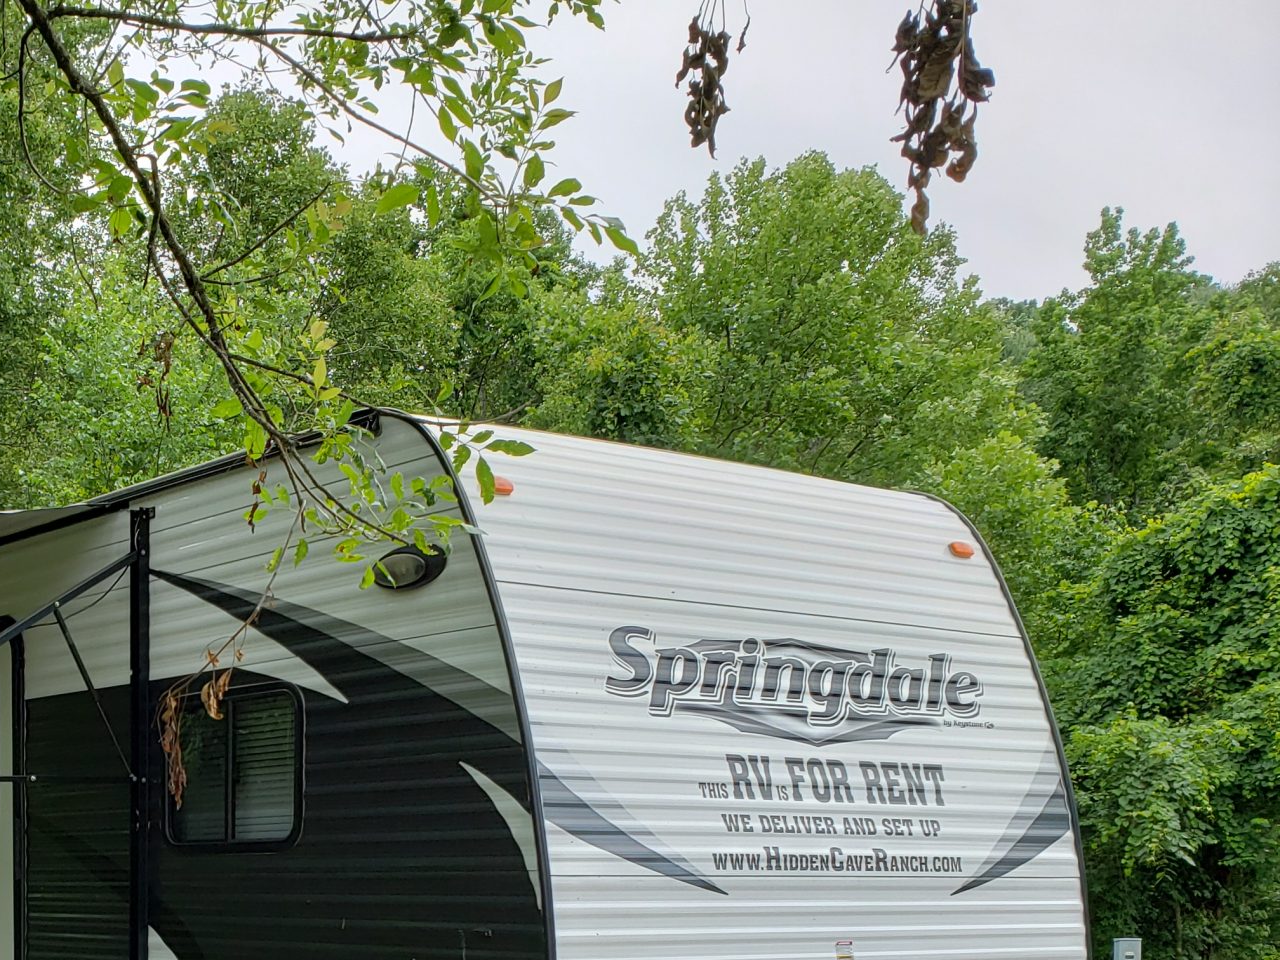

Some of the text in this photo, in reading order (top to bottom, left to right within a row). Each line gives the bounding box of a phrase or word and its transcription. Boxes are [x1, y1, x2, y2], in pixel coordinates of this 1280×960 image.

[605, 625, 983, 727] Springdale
[698, 753, 946, 807] THIS RV IS FOR RENT
[721, 813, 941, 838] WE DELIVER AND SET UP
